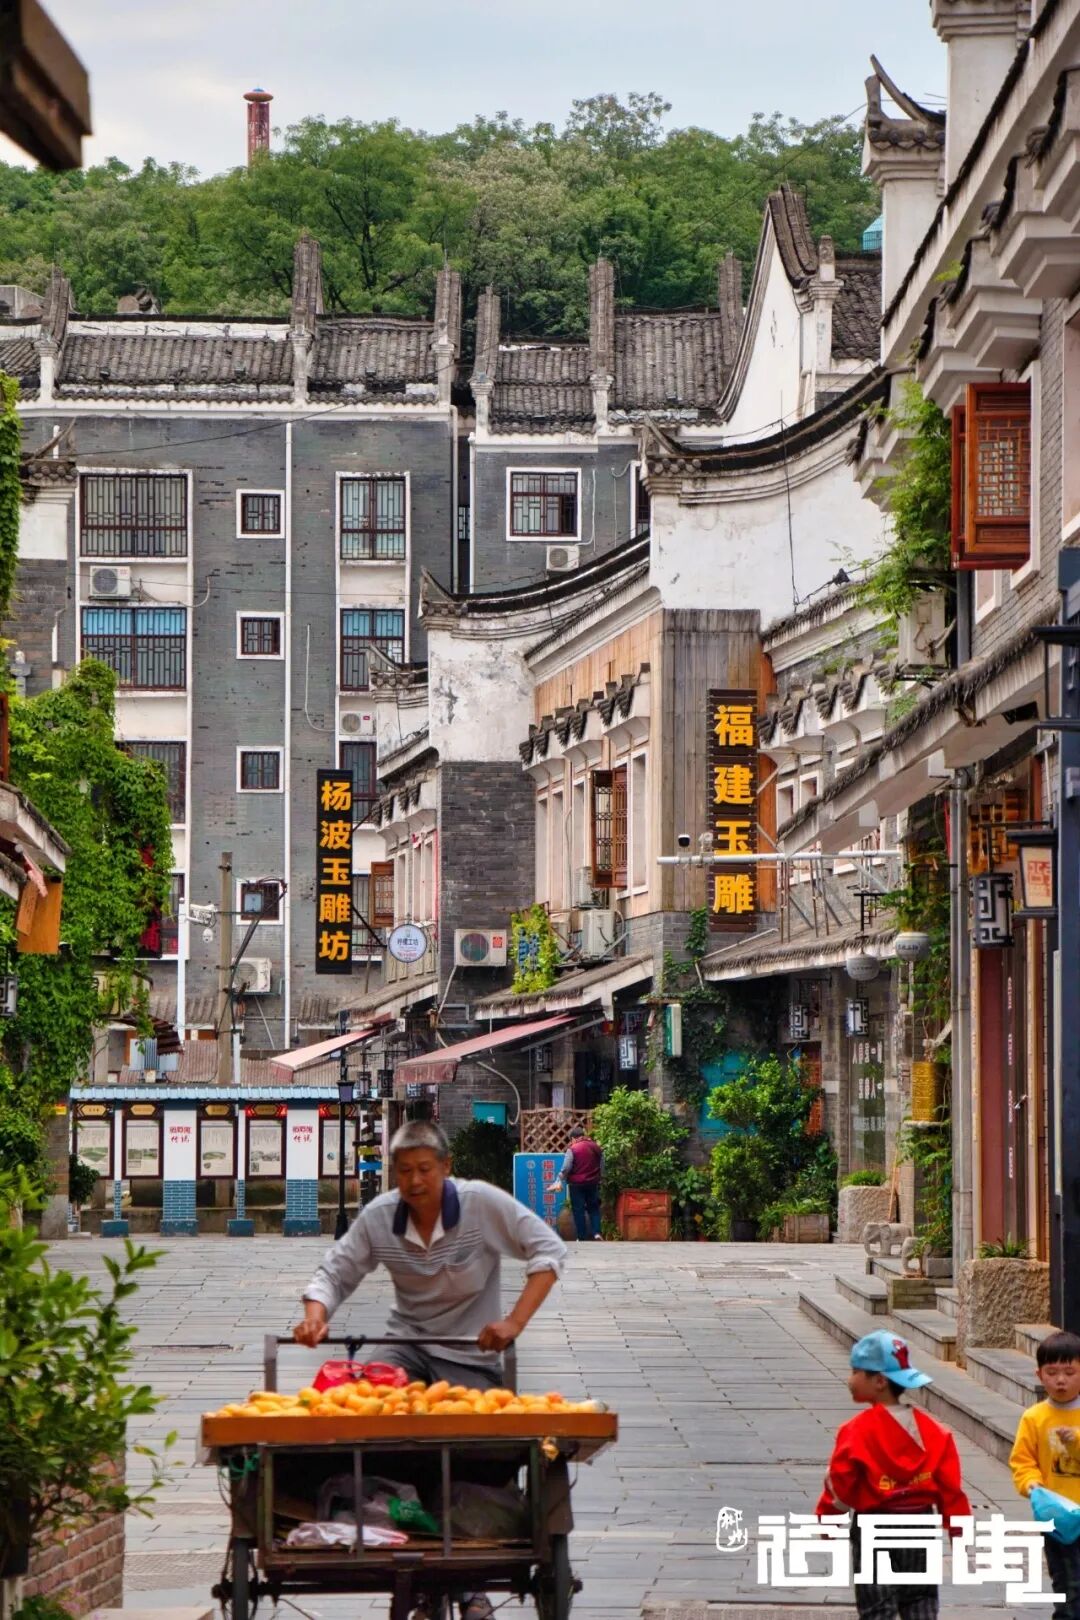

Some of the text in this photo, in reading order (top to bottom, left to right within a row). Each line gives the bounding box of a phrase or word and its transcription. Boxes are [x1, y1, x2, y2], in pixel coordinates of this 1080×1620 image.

[319, 781, 351, 961] 杨波玉雕坊
[713, 705, 754, 913] 福建玉雕
